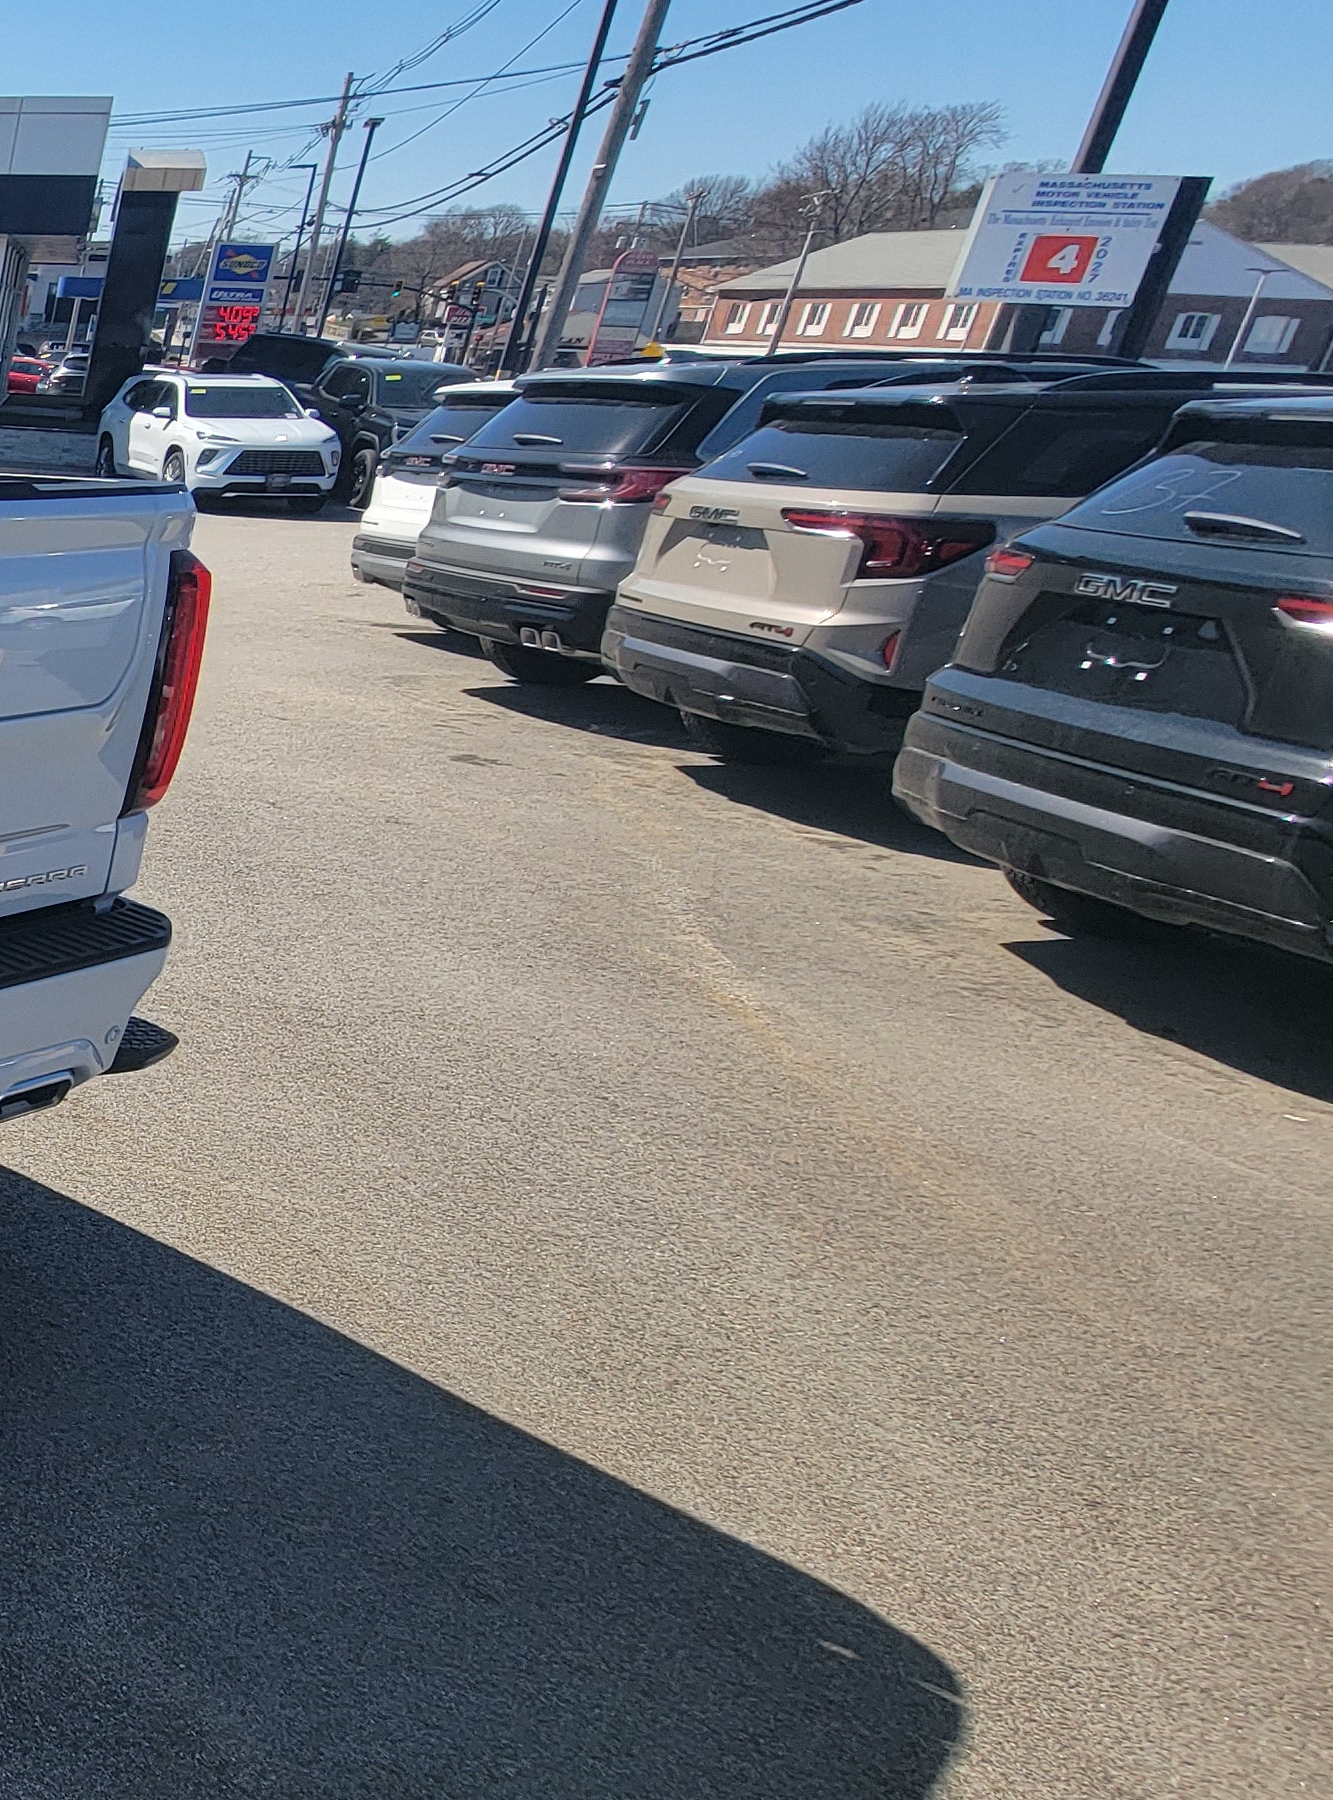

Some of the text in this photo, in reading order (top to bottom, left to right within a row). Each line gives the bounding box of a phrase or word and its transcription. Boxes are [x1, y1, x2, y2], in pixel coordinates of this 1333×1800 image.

[1038, 180, 1153, 190] MASSACHUSETTS
[1035, 190, 1140, 200] MOTOR VEHICLE
[1031, 200, 1165, 210] INSPECTION STATION
[220, 260, 266, 269] SUNOCO
[1047, 243, 1081, 274] 4
[1088, 236, 1113, 283] 2027
[211, 290, 253, 299] ULTRA
[975, 288, 1031, 298] INSPECTION
[1035, 289, 1073, 300] STATION
[689, 505, 740, 524] GMC
[1074, 572, 1180, 609] GMC
[749, 621, 794, 637] AT4
